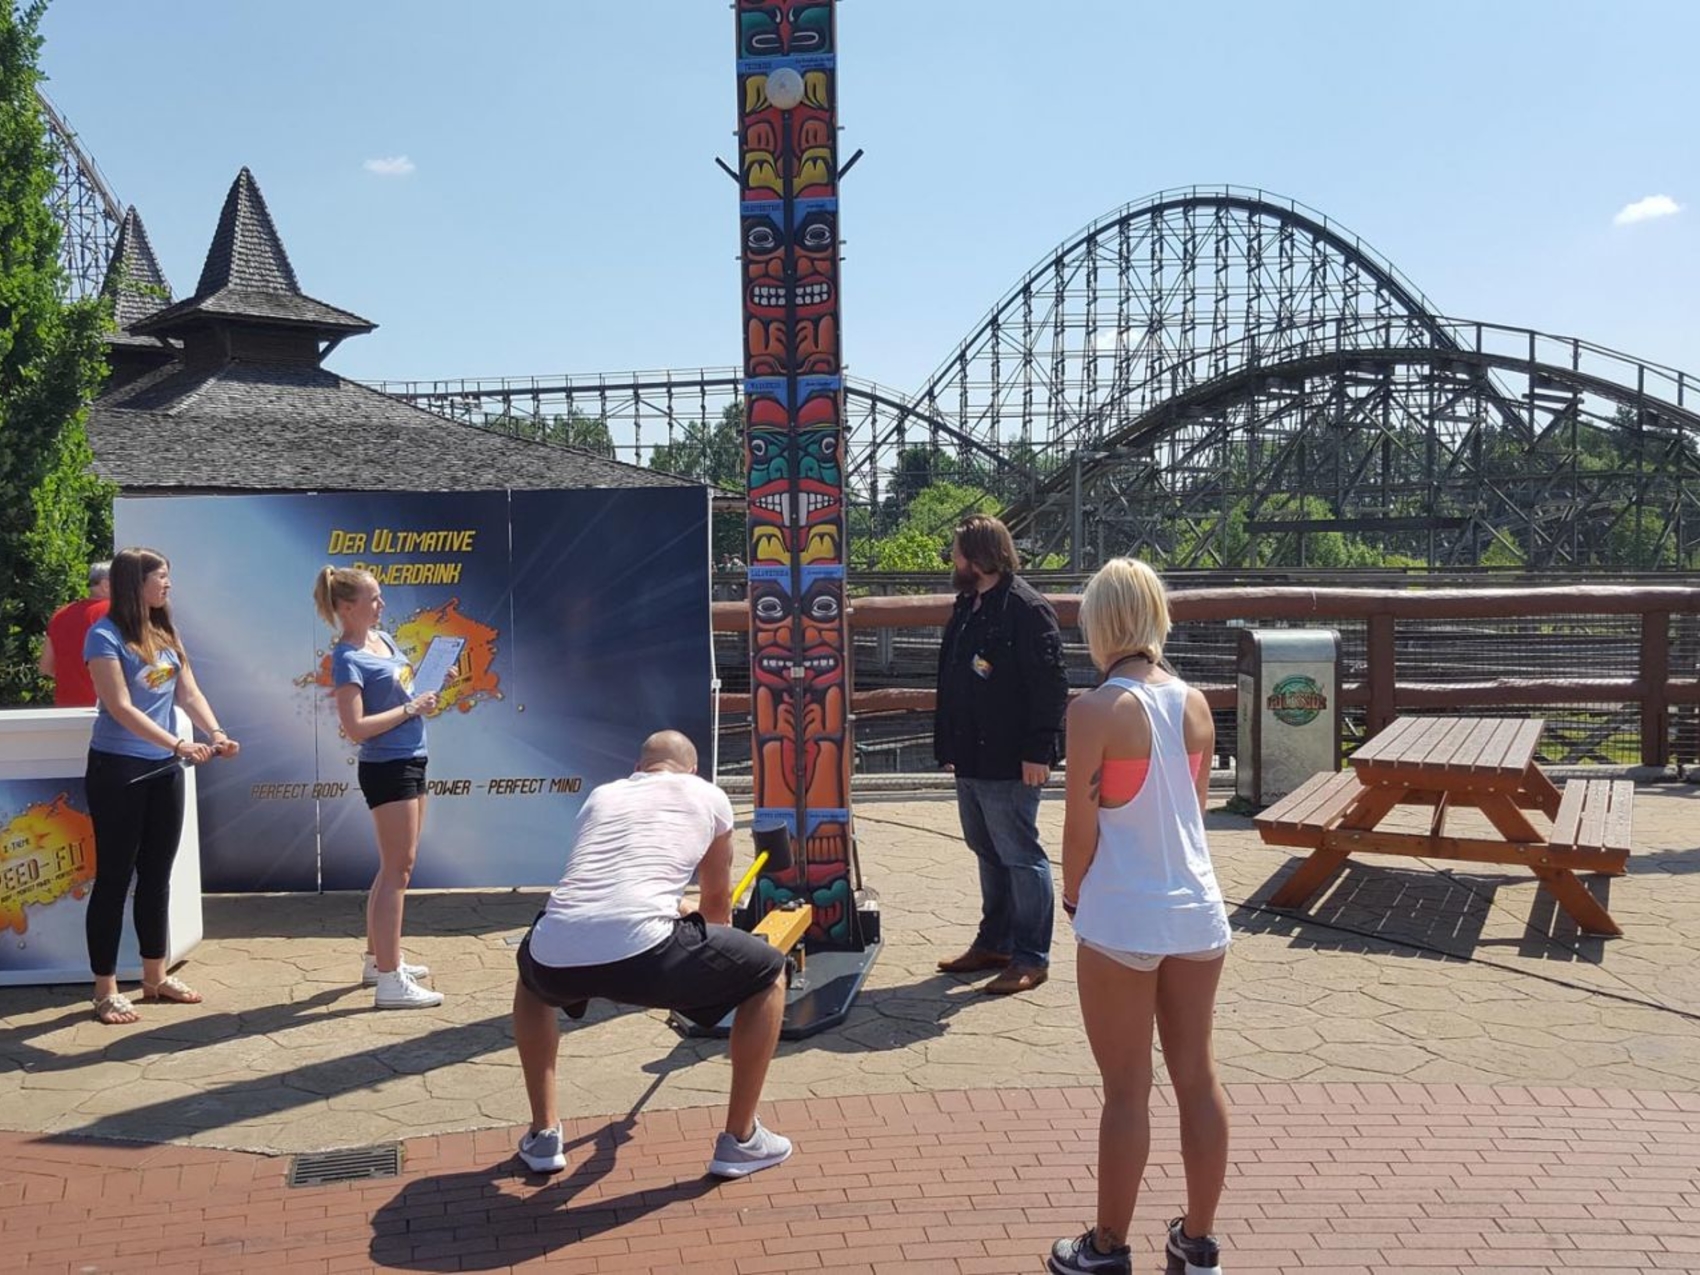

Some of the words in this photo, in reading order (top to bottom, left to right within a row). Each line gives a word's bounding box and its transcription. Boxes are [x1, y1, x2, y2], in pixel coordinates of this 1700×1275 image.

[251, 783, 308, 799] PERFECT
[312, 783, 349, 798] BODY
[427, 780, 472, 796] POWER
[488, 778, 547, 795] PERFECT
[549, 778, 583, 793] MIND
